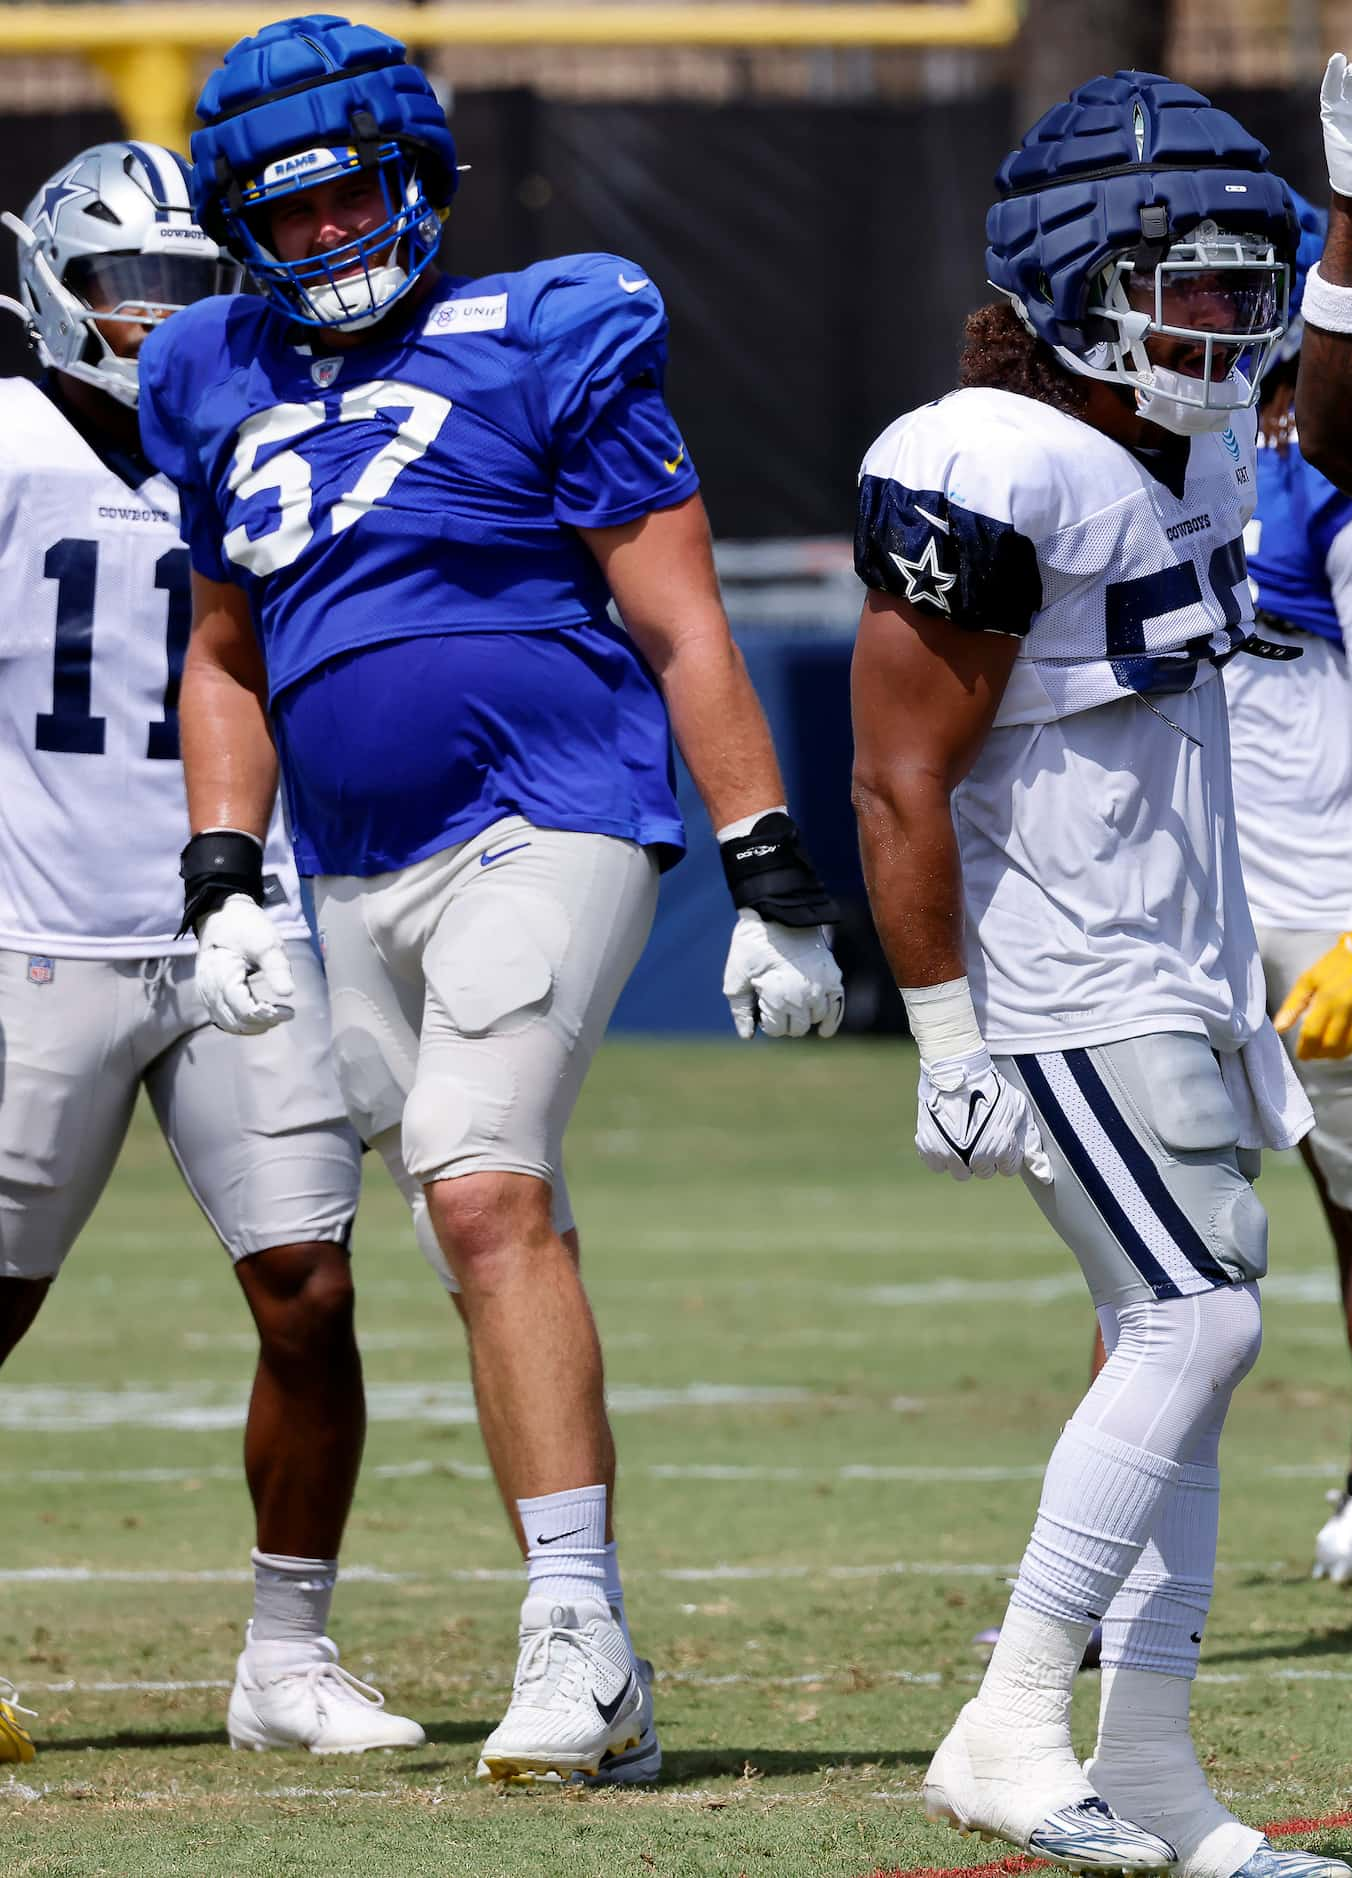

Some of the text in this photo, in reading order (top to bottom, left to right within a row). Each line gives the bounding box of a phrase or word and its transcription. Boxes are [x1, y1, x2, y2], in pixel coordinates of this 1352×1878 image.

[274, 152, 318, 176] RAMS
[223, 379, 453, 578] 57
[1234, 465, 1250, 485] AT&T
[97, 506, 170, 523] COWBOYS
[1166, 514, 1212, 541] COWBOYS
